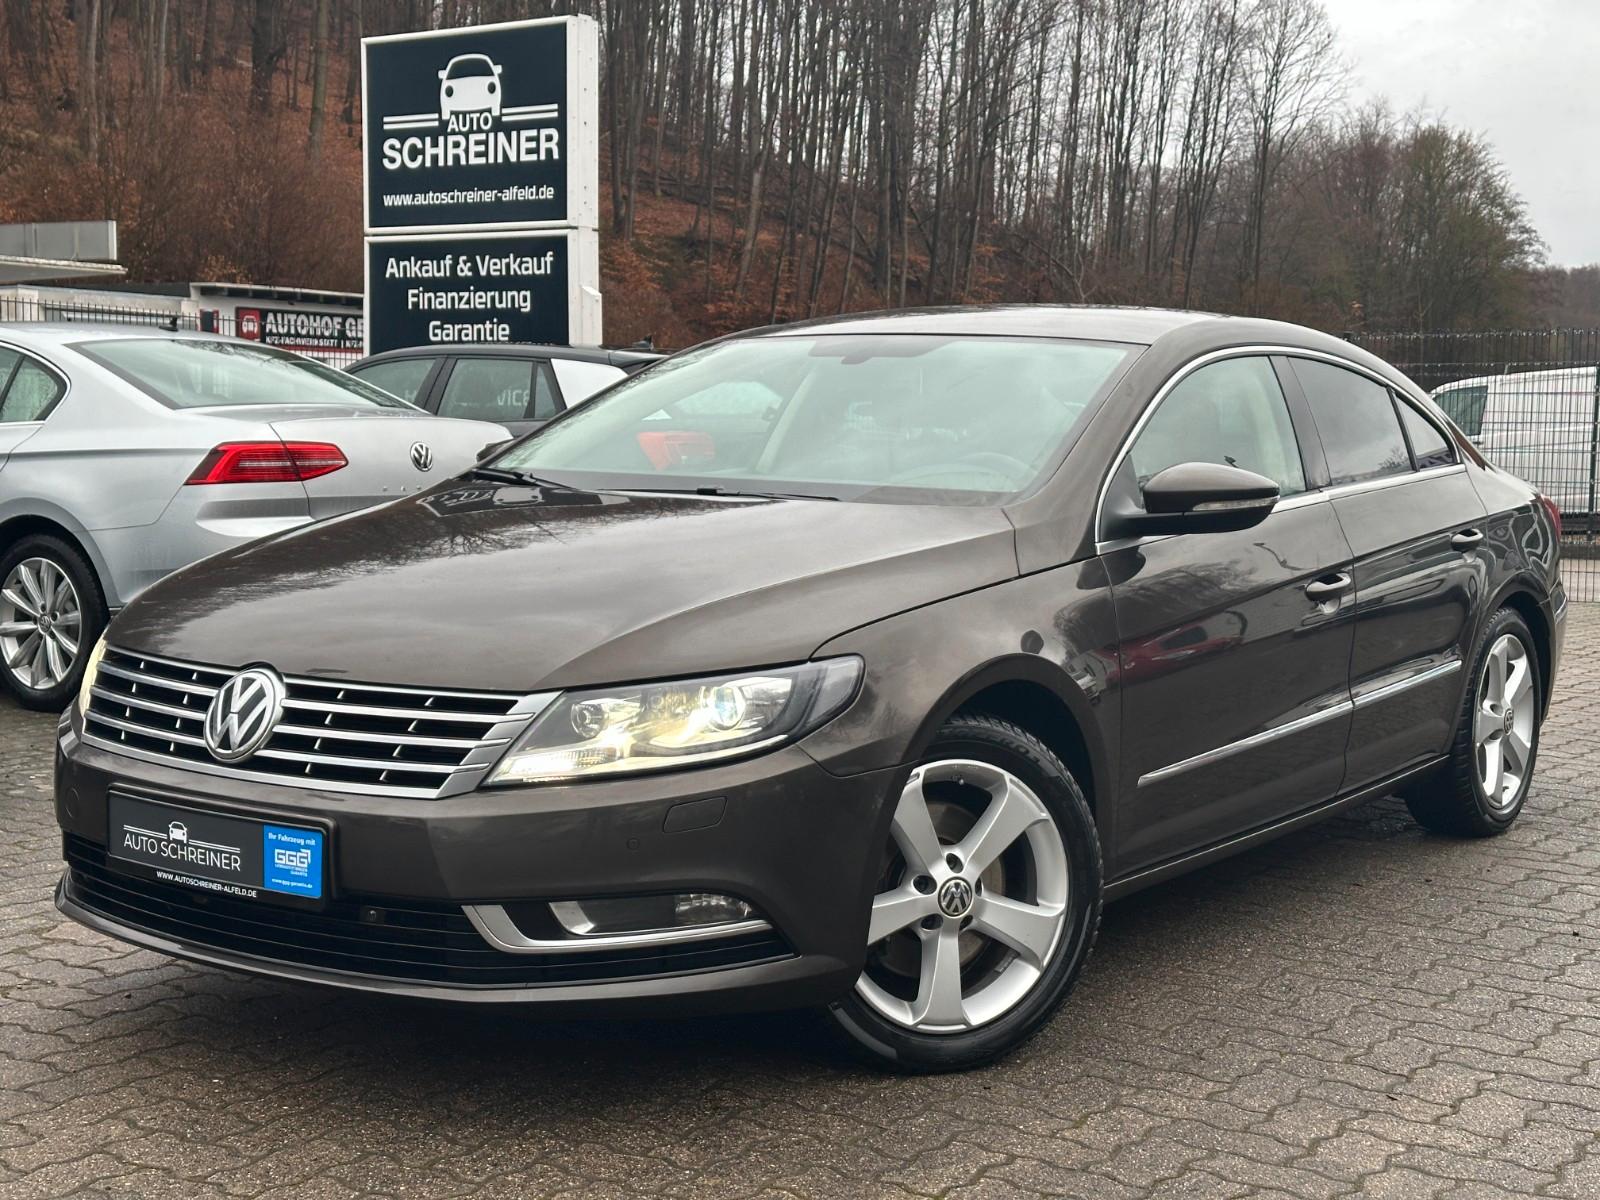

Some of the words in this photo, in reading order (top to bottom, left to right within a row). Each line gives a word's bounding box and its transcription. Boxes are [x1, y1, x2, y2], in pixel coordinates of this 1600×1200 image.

[447, 112, 492, 132] AUTO
[382, 128, 560, 170] SCHREINER
[383, 184, 554, 207] www.autoschreiner-alfeld.de
[385, 254, 452, 279] Ankauf
[457, 256, 473, 277] &
[475, 252, 554, 276] Verkauf
[407, 287, 531, 312] Finanzierung
[266, 312, 343, 337] AUTOHOF
[428, 318, 510, 342] Garantie
[278, 833, 305, 846] Fahrzeug
[306, 838, 316, 846] mit
[123, 833, 158, 854] AUTO
[160, 842, 241, 872] SCHREINER
[274, 848, 309, 868] GGG
[156, 871, 257, 898] WWW.AUTOSCHREINER-ALFELD.DE
